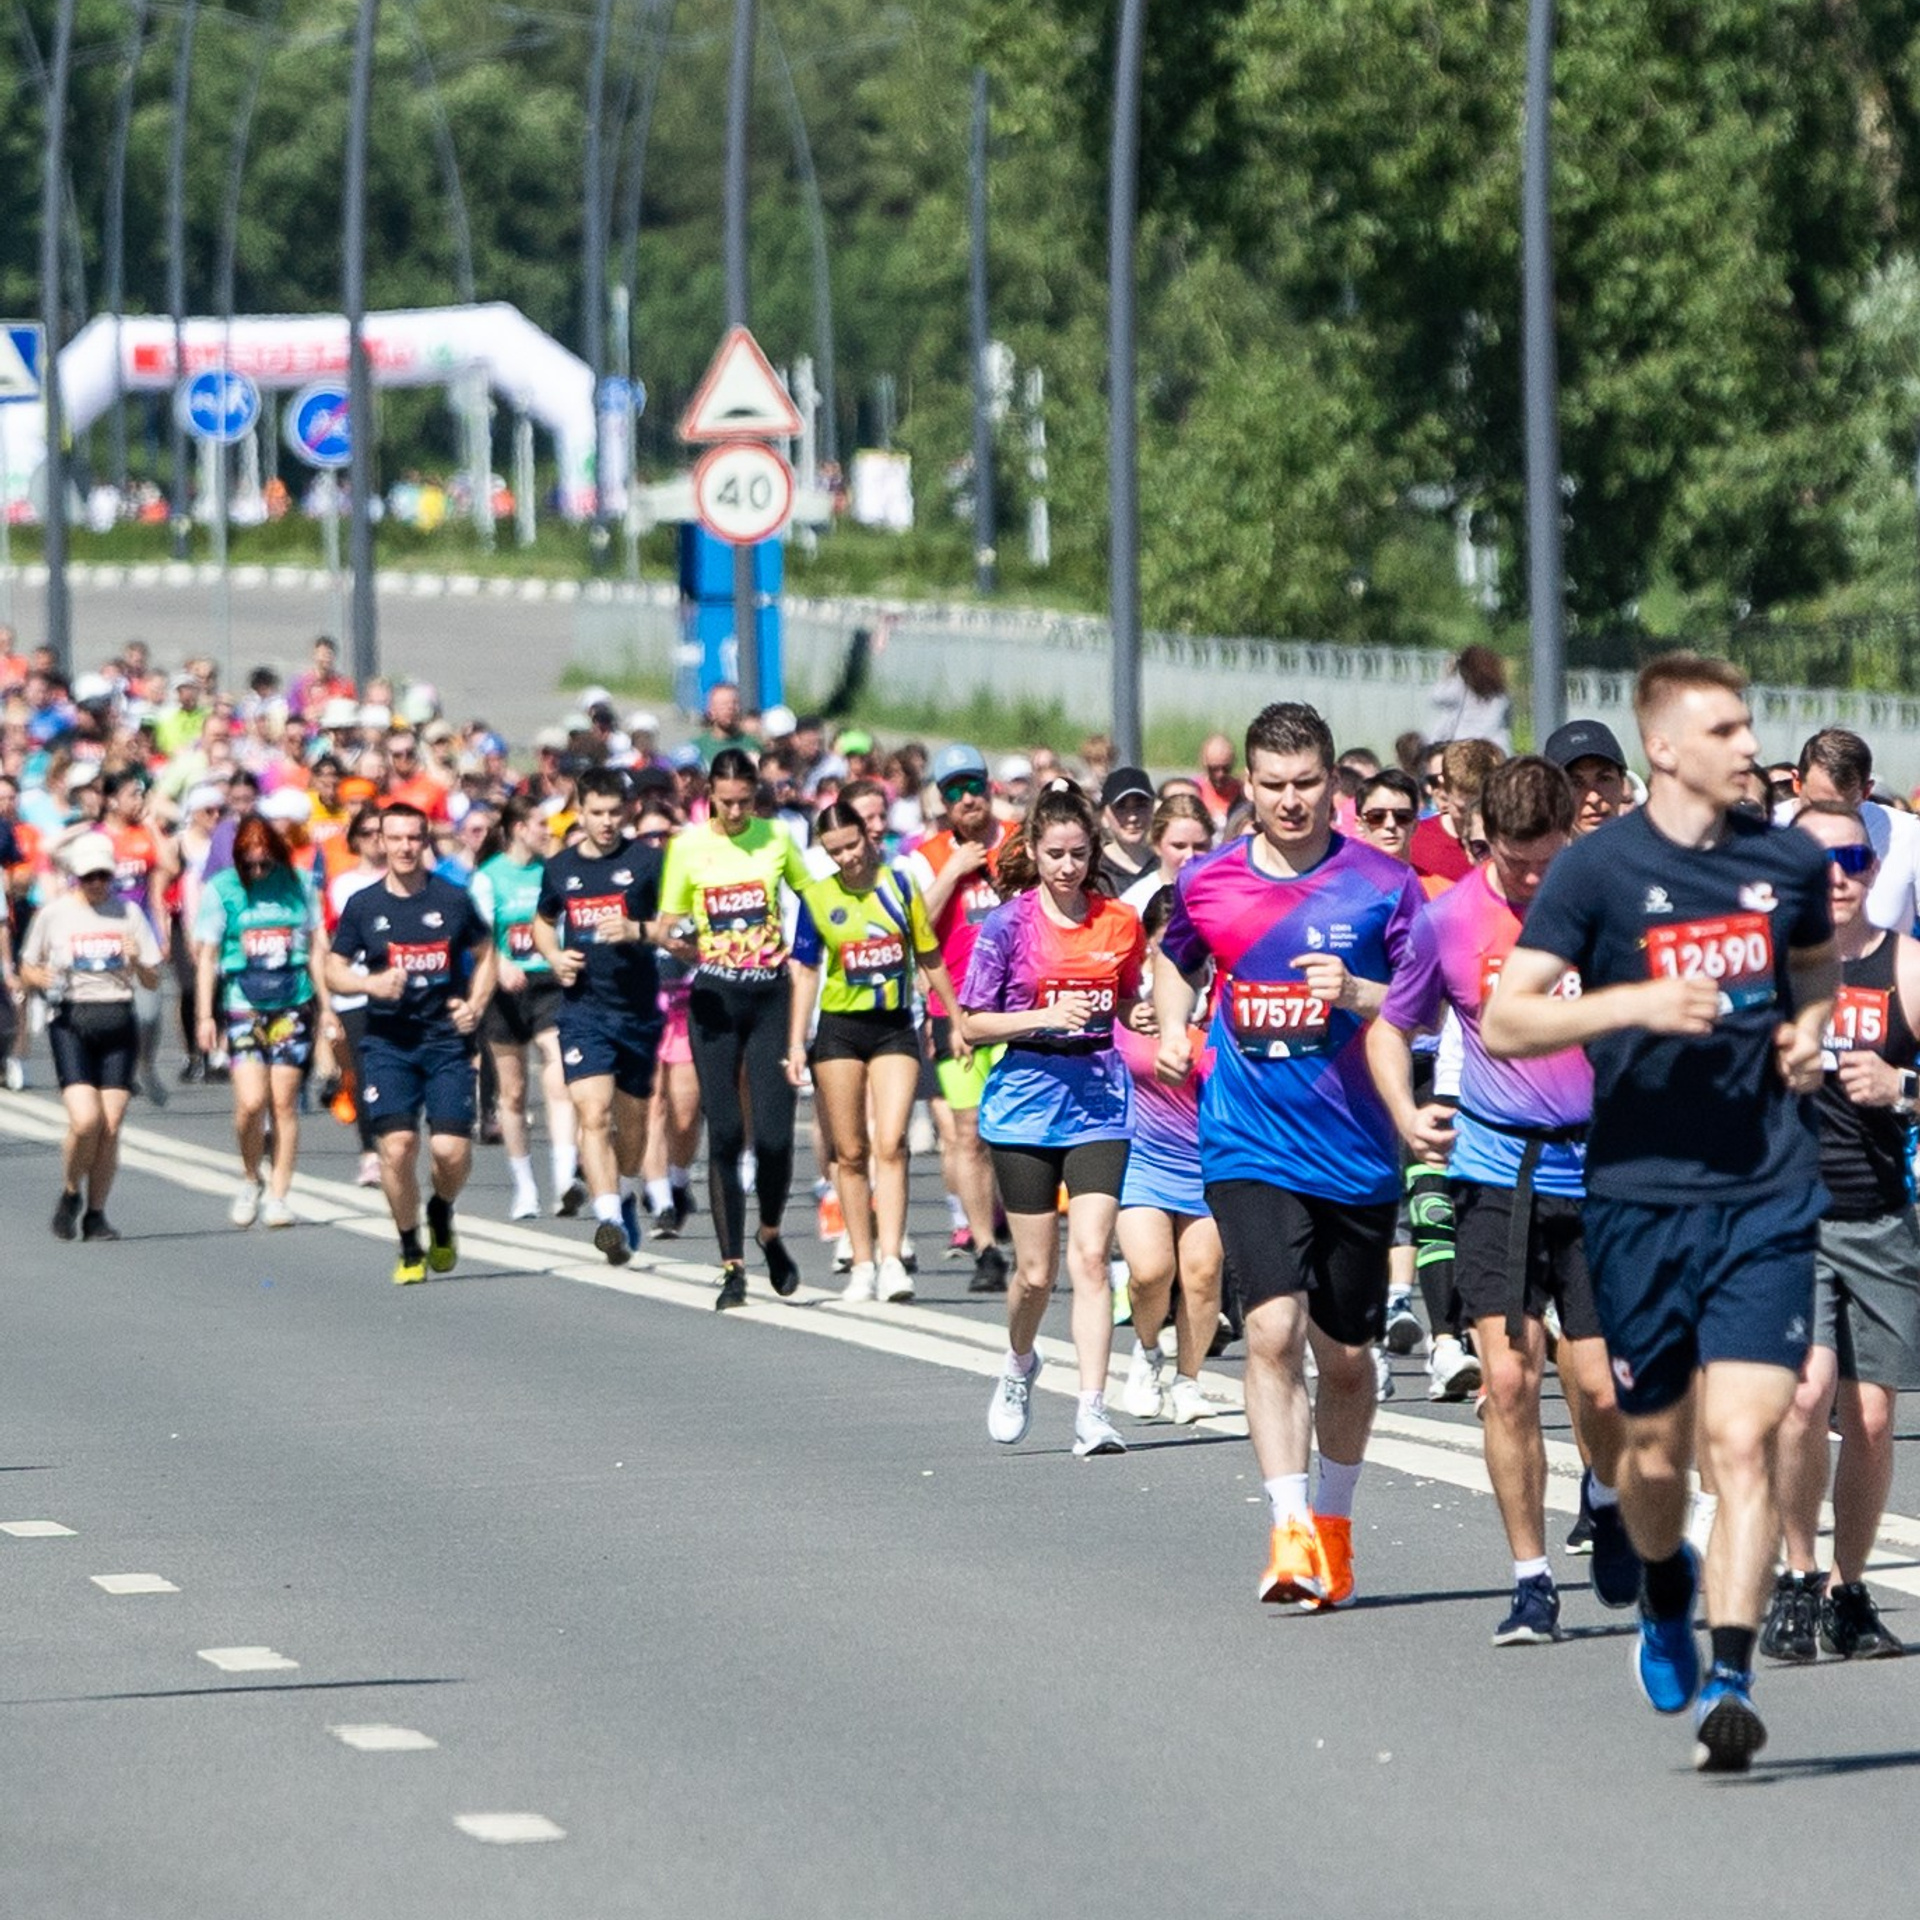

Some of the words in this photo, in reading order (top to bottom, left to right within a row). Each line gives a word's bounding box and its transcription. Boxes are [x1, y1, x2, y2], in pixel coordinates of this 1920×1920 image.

[717, 475, 772, 511] 40
[707, 889, 766, 915] 14282
[395, 950, 447, 971] 12689
[845, 943, 903, 969] 14283
[1660, 932, 1768, 980] 12690
[699, 962, 737, 980] NIKE
[740, 968, 777, 983] PRO
[1045, 989, 1113, 1011] 128
[1238, 998, 1325, 1027] 17572
